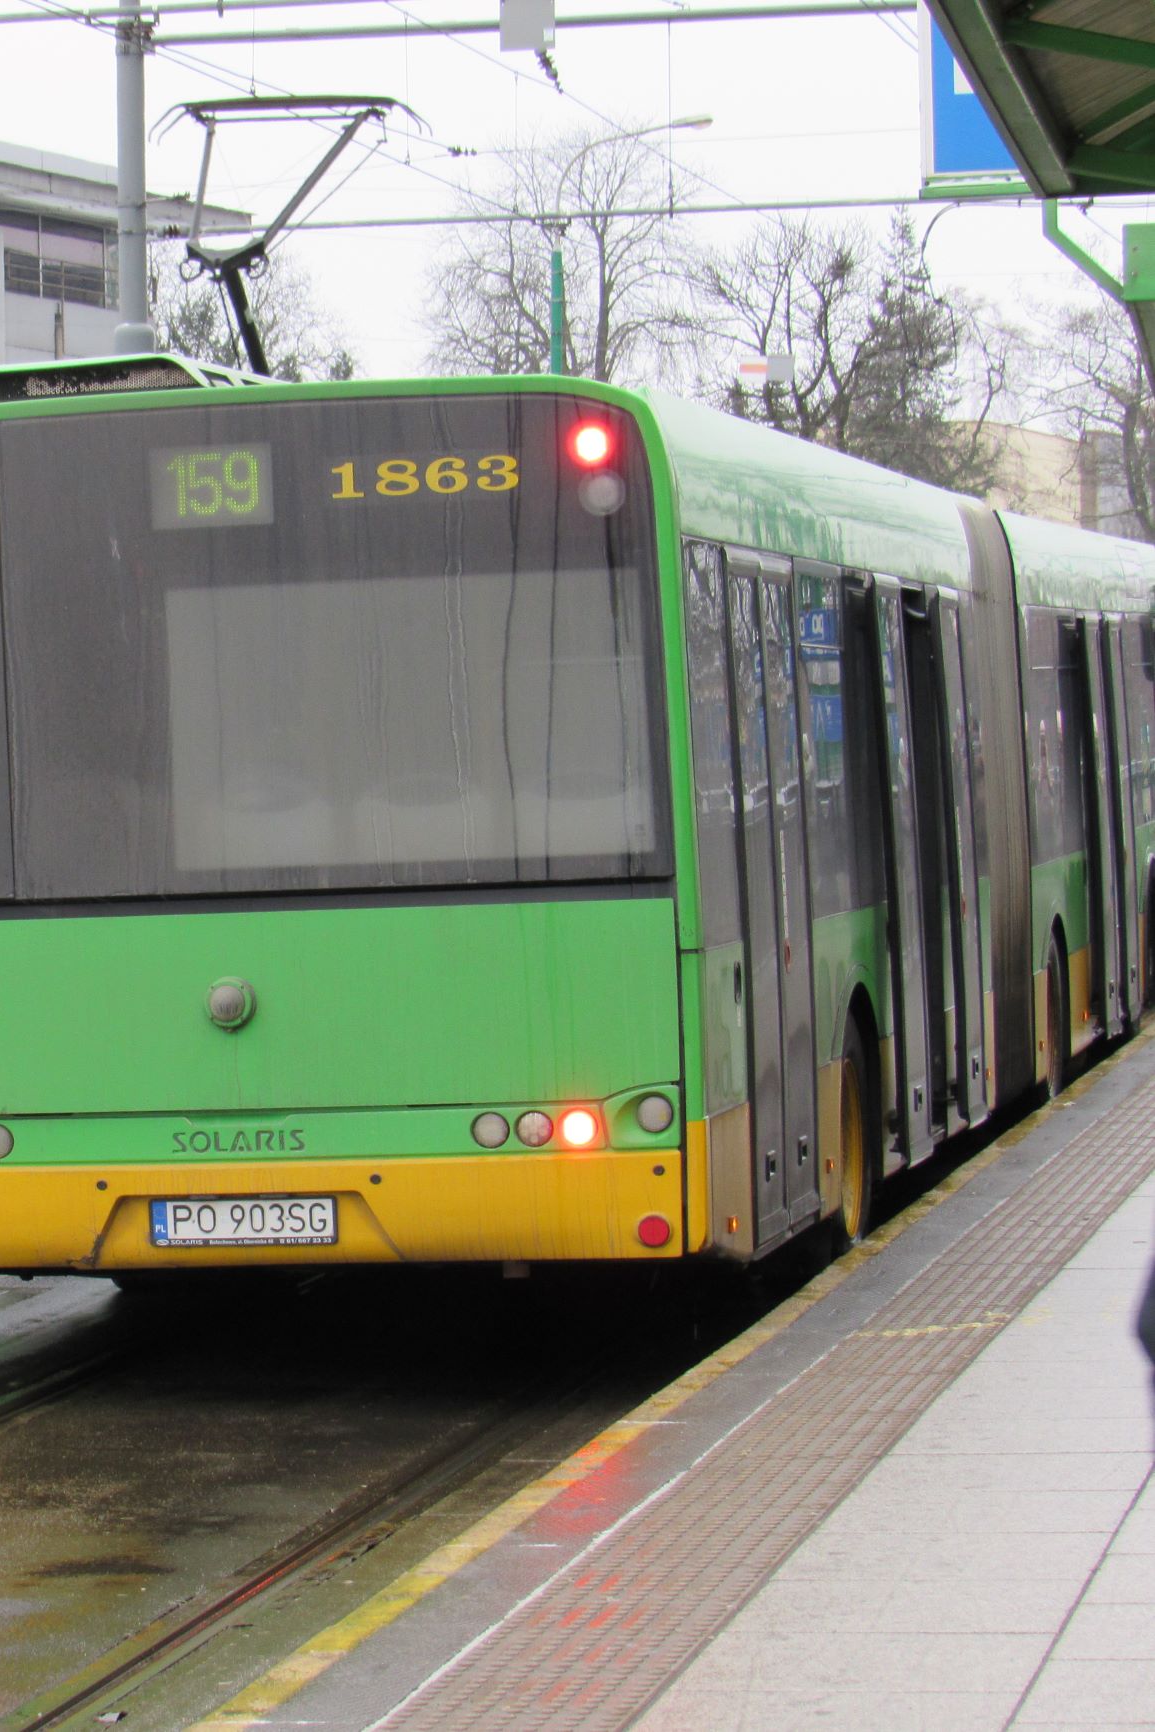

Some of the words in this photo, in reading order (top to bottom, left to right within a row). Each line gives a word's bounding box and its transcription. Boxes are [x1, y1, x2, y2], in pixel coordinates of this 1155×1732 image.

[166, 451, 259, 515] 159
[331, 454, 519, 499] 1863
[171, 1129, 306, 1154] SOLARIS
[155, 1224, 166, 1233] PL
[173, 1204, 216, 1234] PO
[230, 1202, 327, 1234] 903SG
